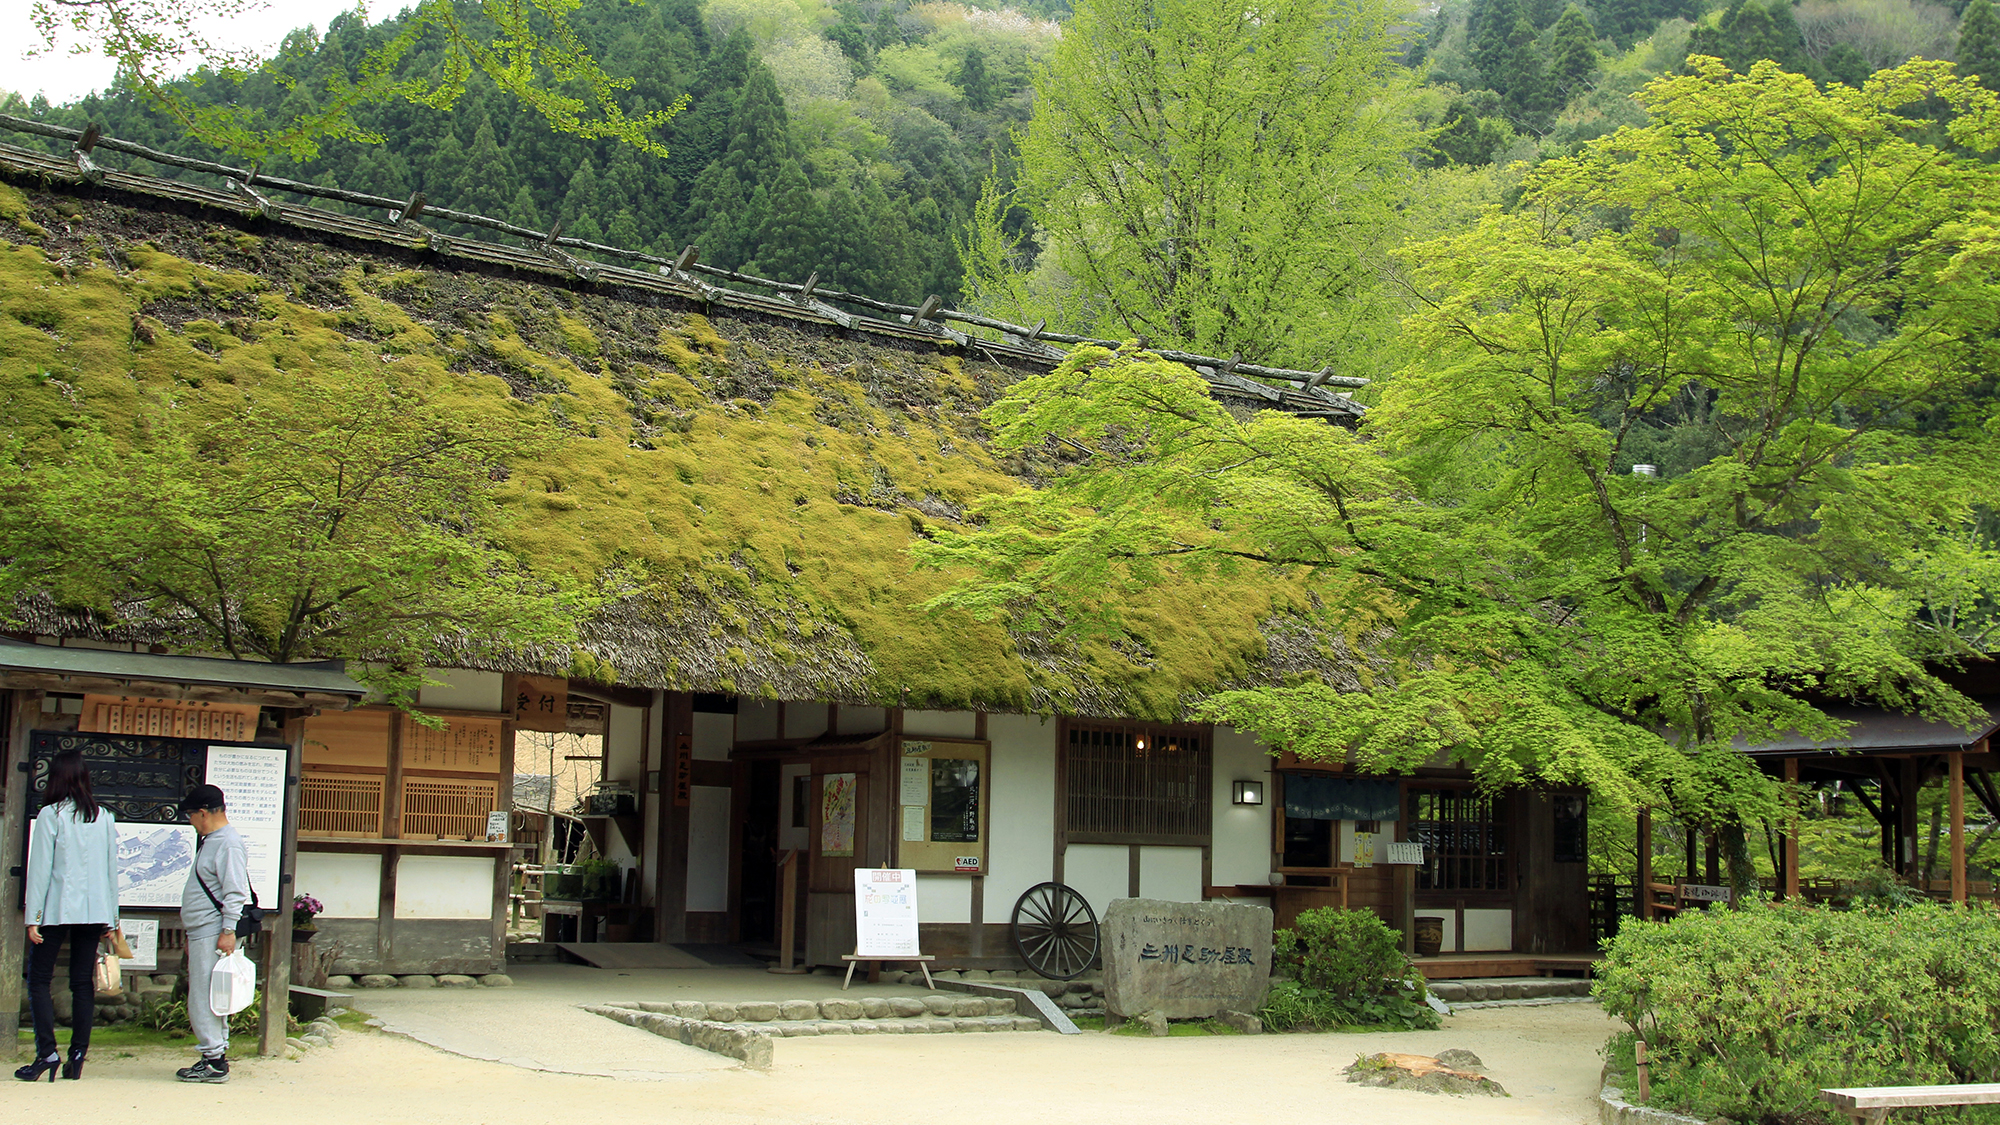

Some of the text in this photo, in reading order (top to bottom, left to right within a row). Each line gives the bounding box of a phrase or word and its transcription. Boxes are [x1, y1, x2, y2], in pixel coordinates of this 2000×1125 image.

[517, 692, 555, 713] 受付
[872, 871, 901, 882] 開催中
[1137, 942, 1255, 965] 三州足助屋敷
